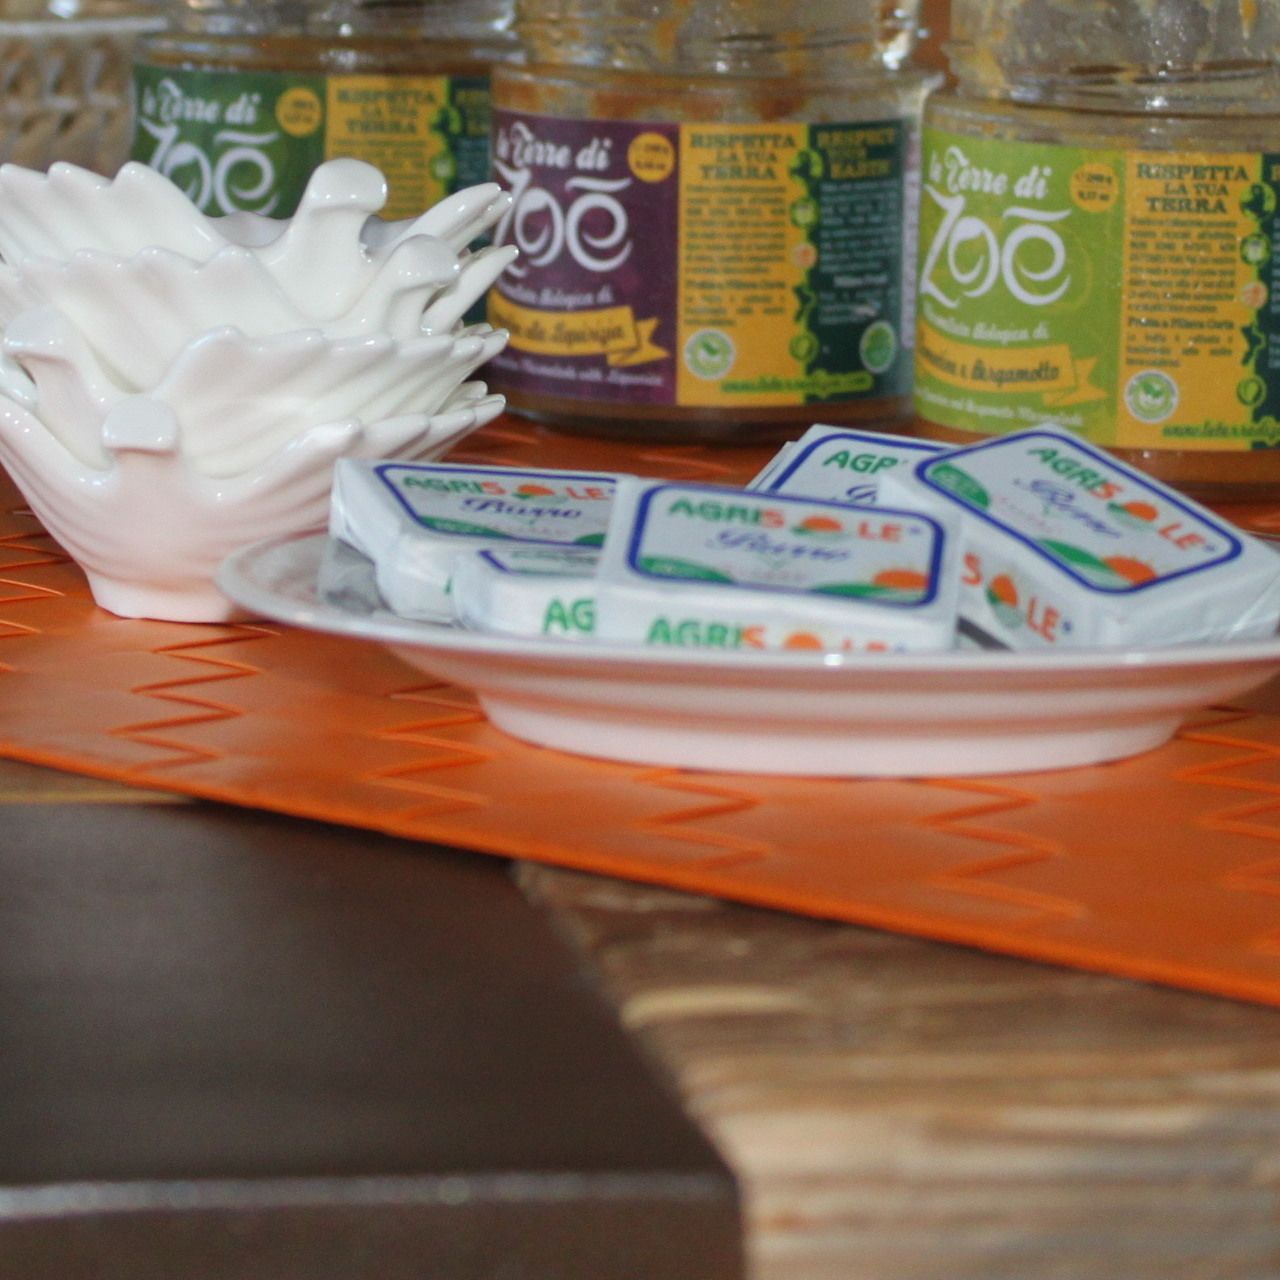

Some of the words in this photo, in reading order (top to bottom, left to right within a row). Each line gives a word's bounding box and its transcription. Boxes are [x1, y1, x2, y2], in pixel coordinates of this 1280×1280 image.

[225, 93, 261, 125] di
[575, 137, 613, 171] di
[944, 145, 1008, 195] Terre
[1014, 165, 1052, 200] di
[1136, 164, 1249, 181] RISPETTA
[1164, 184, 1187, 196] LA
[1194, 184, 1229, 196] TUA
[1146, 198, 1227, 214] TERRA
